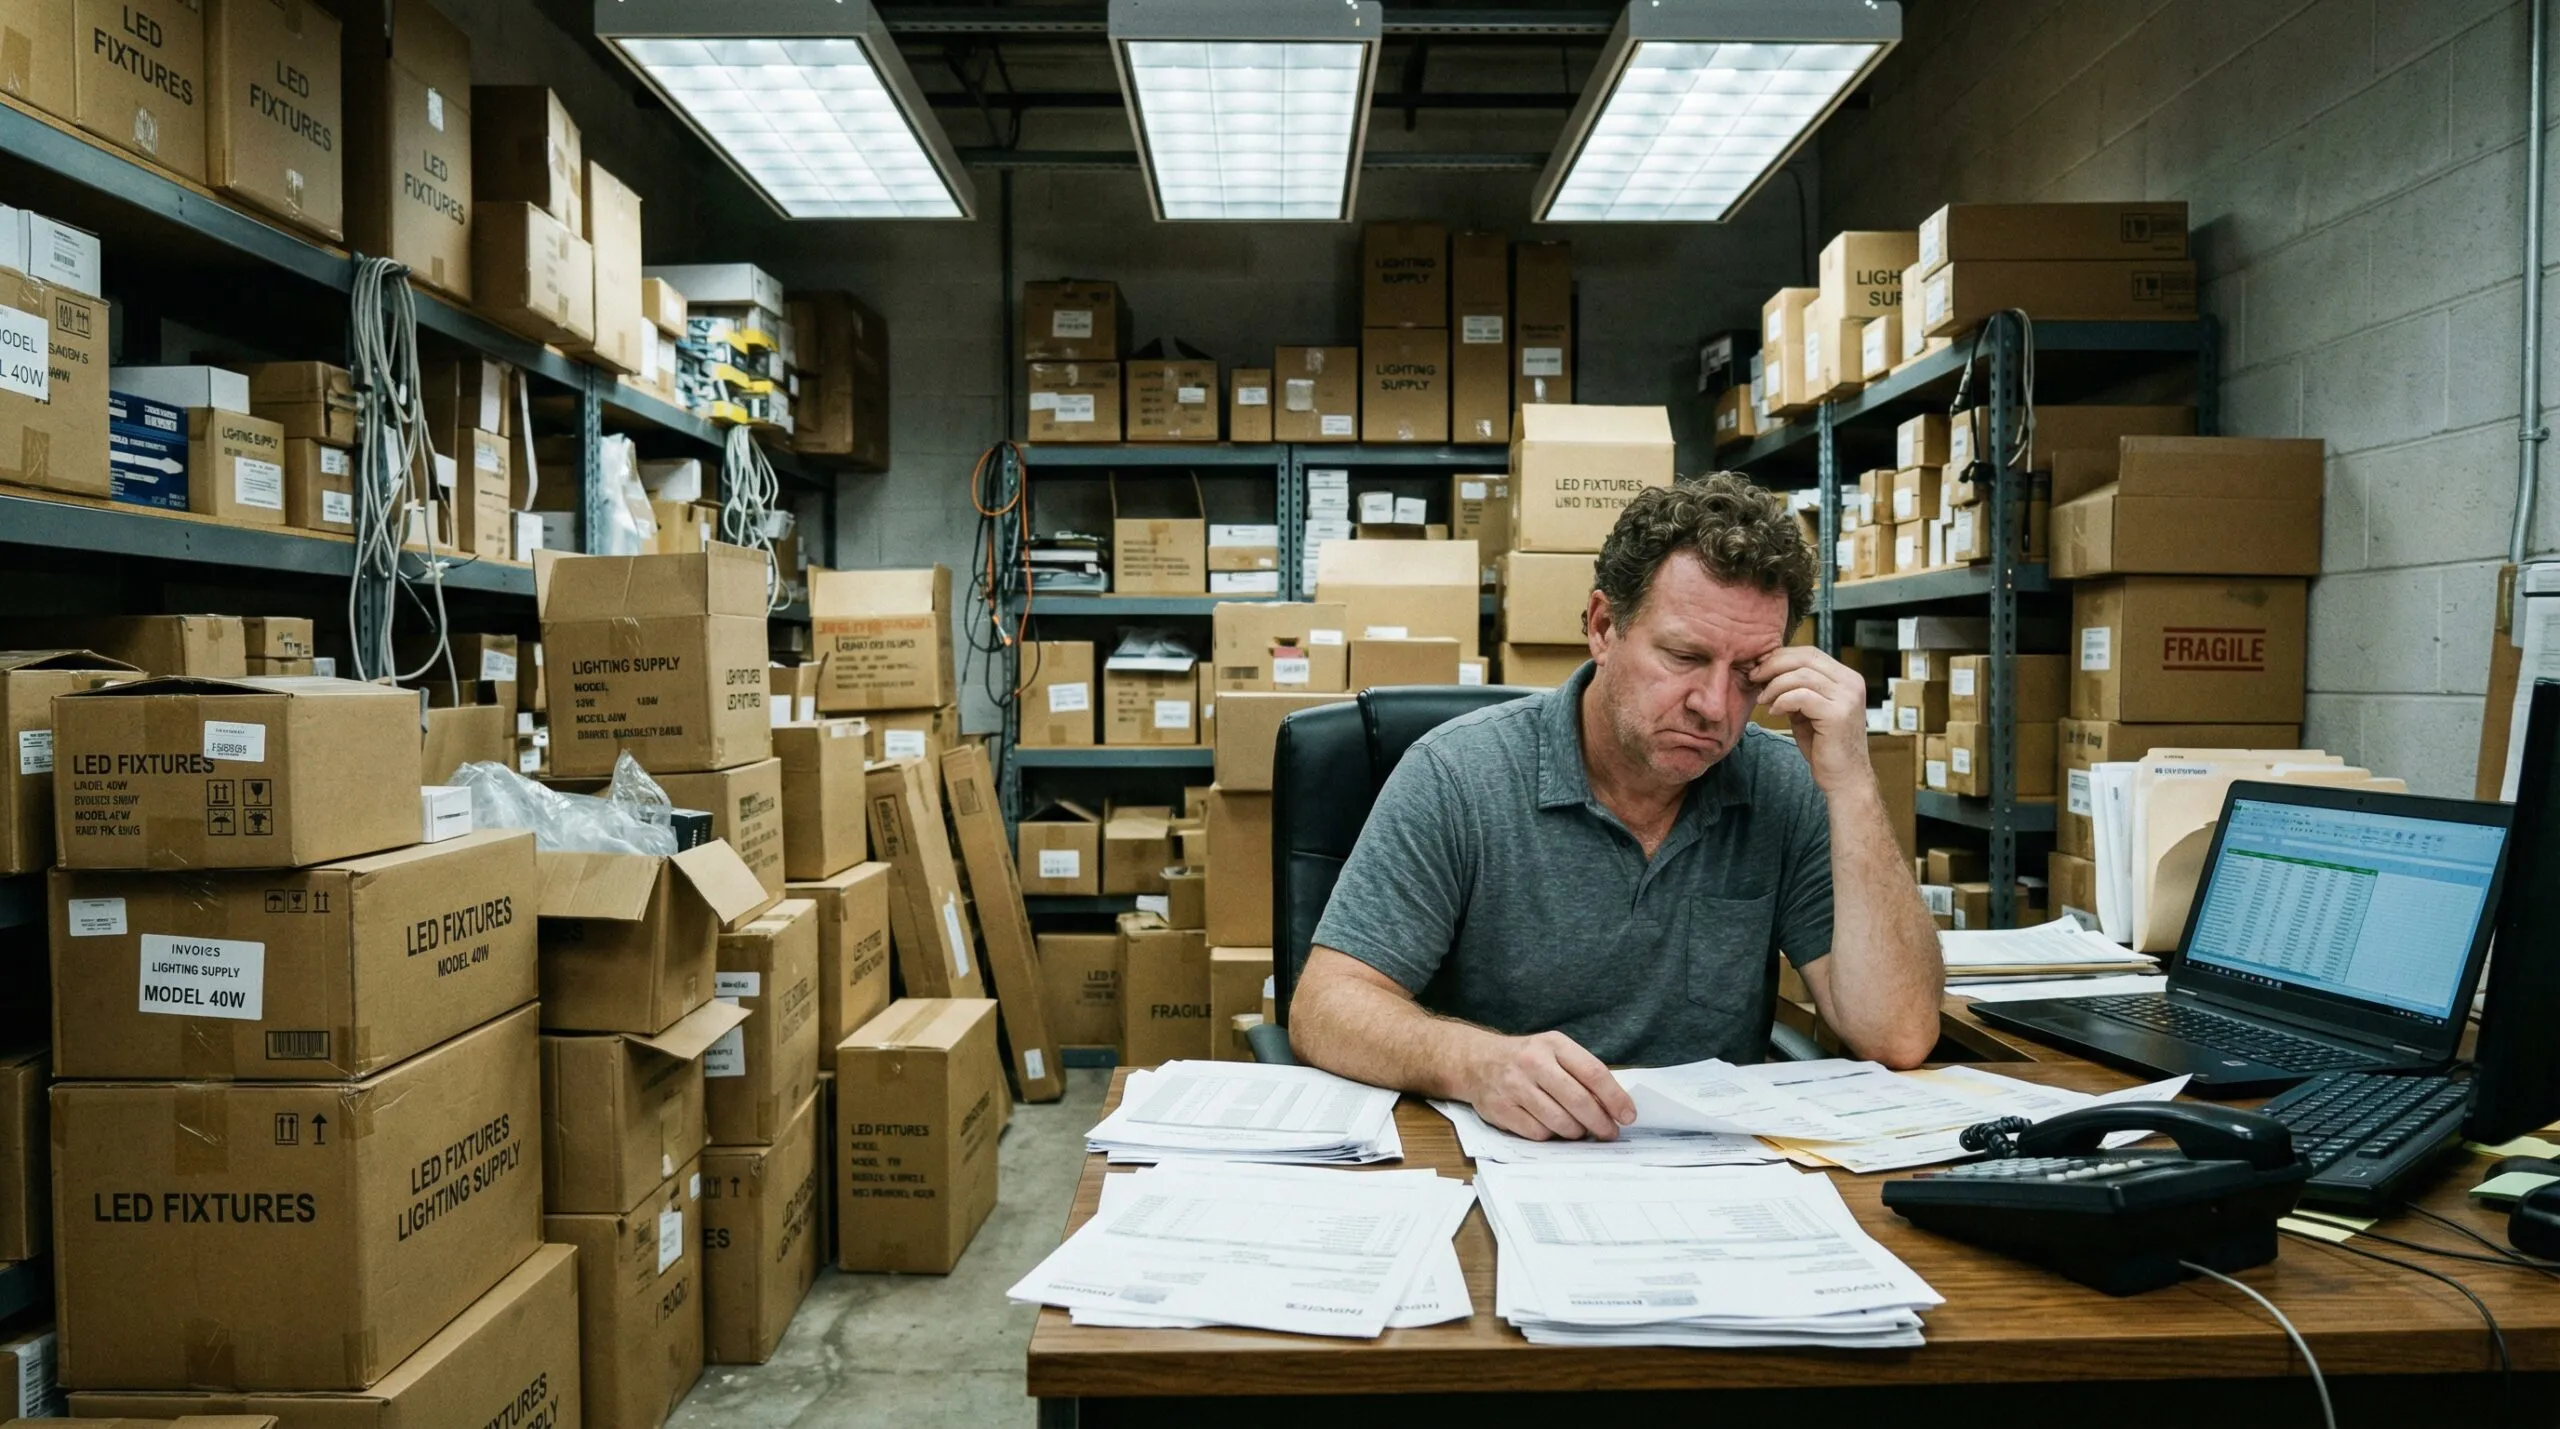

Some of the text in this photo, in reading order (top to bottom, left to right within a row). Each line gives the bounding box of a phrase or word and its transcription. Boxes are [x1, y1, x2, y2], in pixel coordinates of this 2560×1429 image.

[124, 5, 163, 48] LED
[94, 27, 193, 106] FIXTURES
[277, 60, 309, 98] LED
[250, 83, 332, 152] FIXTURES
[423, 150, 448, 182] LED
[404, 172, 465, 226] FIXTURES
[11, 363, 44, 388] 40W
[1376, 364, 1436, 376] LIGHTING
[1381, 379, 1430, 391] SUPPLY
[1555, 478, 1643, 492] LED FIXTURES
[2164, 636, 2265, 662] FRAGILE
[572, 656, 680, 675] LIGHTING SUPPLY
[73, 753, 216, 775] LED FIXTURES
[407, 918, 439, 957] LED
[443, 895, 512, 945] FIXTURES
[152, 962, 240, 978] LIGHTING SUPPLY
[437, 951, 470, 978] MODEL
[144, 984, 246, 1009] MODEL 40W
[1151, 1004, 1212, 1019] FRAGILE
[851, 1123, 930, 1137] LED FIXTURES
[411, 1113, 510, 1195] LED FIXTURES
[398, 1139, 521, 1243] LIGHTING SUPPLY
[94, 1193, 316, 1224] LED FIXTURES
